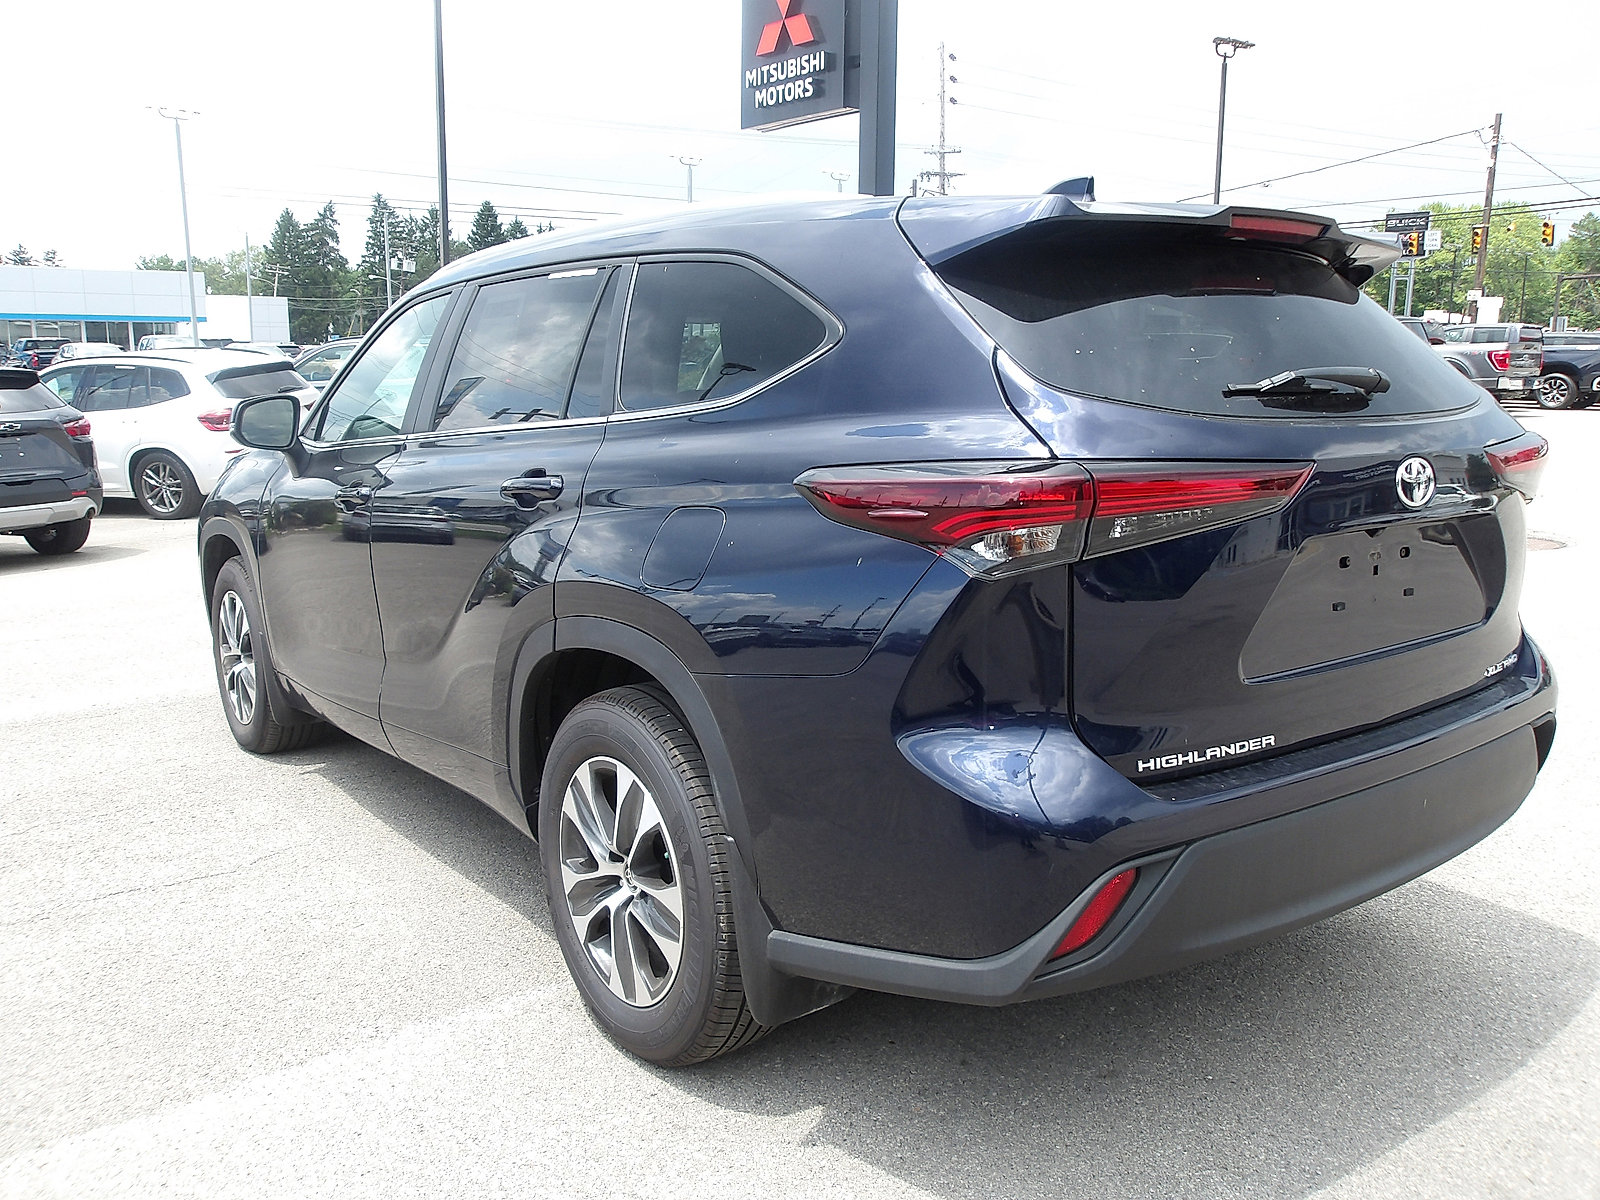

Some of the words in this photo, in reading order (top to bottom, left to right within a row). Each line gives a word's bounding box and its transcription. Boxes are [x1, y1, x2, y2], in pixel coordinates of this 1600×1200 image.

[745, 50, 825, 89] MITSUBISHI
[754, 76, 814, 109] MOTORS
[1387, 217, 1425, 227] BUICK
[1137, 734, 1276, 773] HIGHLANDER
